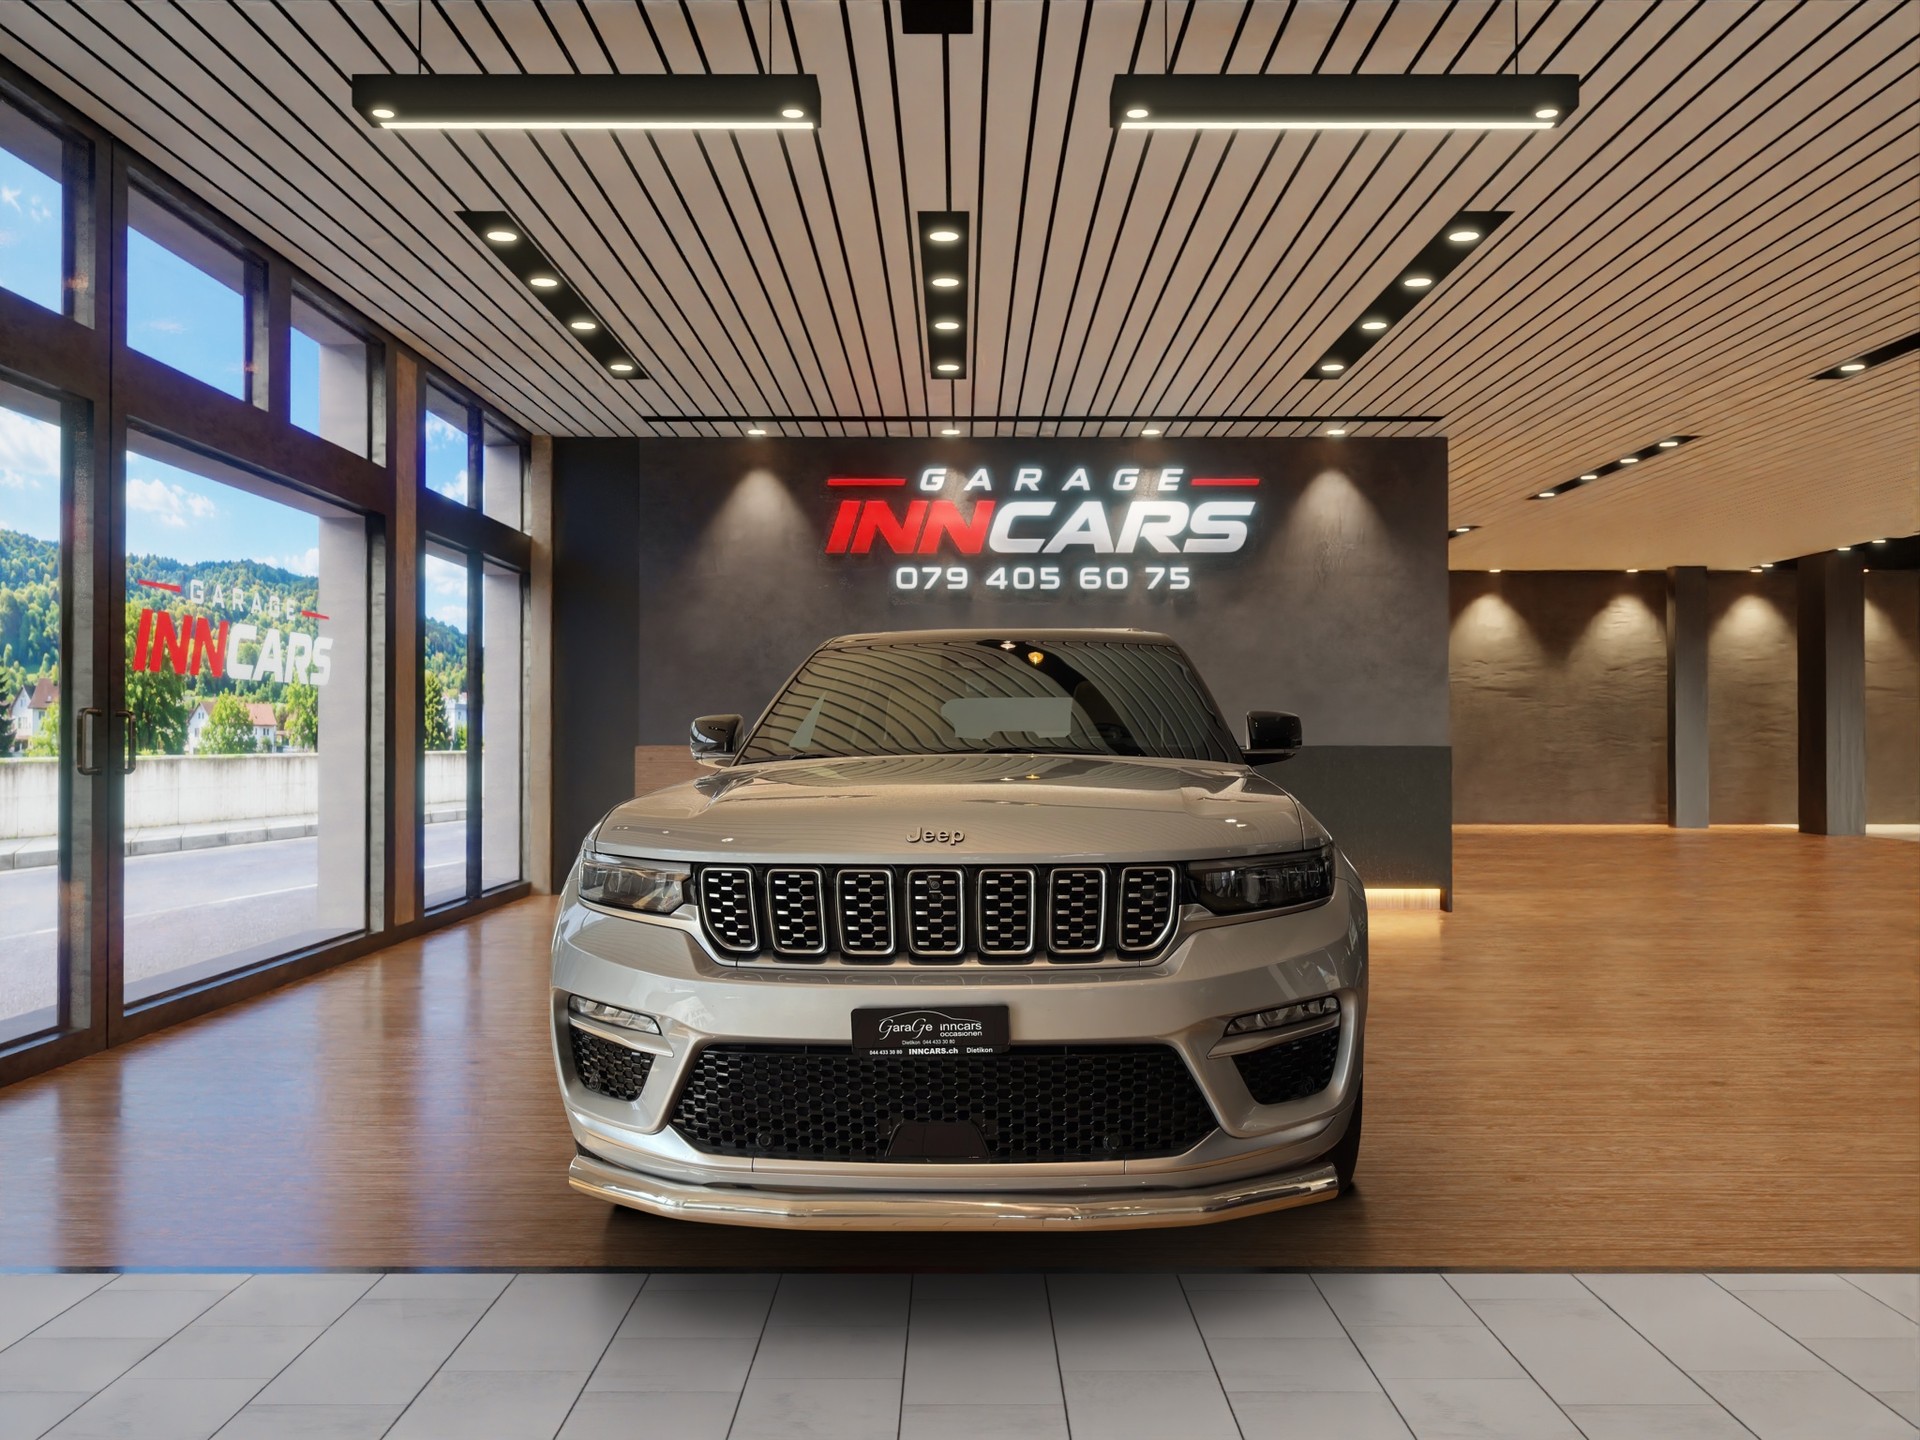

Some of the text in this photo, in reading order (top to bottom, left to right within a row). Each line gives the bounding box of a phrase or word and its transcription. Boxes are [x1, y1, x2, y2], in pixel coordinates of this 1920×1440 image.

[919, 468, 1185, 491] GARAGE
[825, 500, 1257, 554] INNCARS
[895, 567, 1191, 590] 079 405 60 75
[189, 579, 296, 621] GARAGE
[133, 608, 334, 686] INNCARS
[906, 827, 965, 846] Jeep
[940, 1022, 982, 1031] inncars
